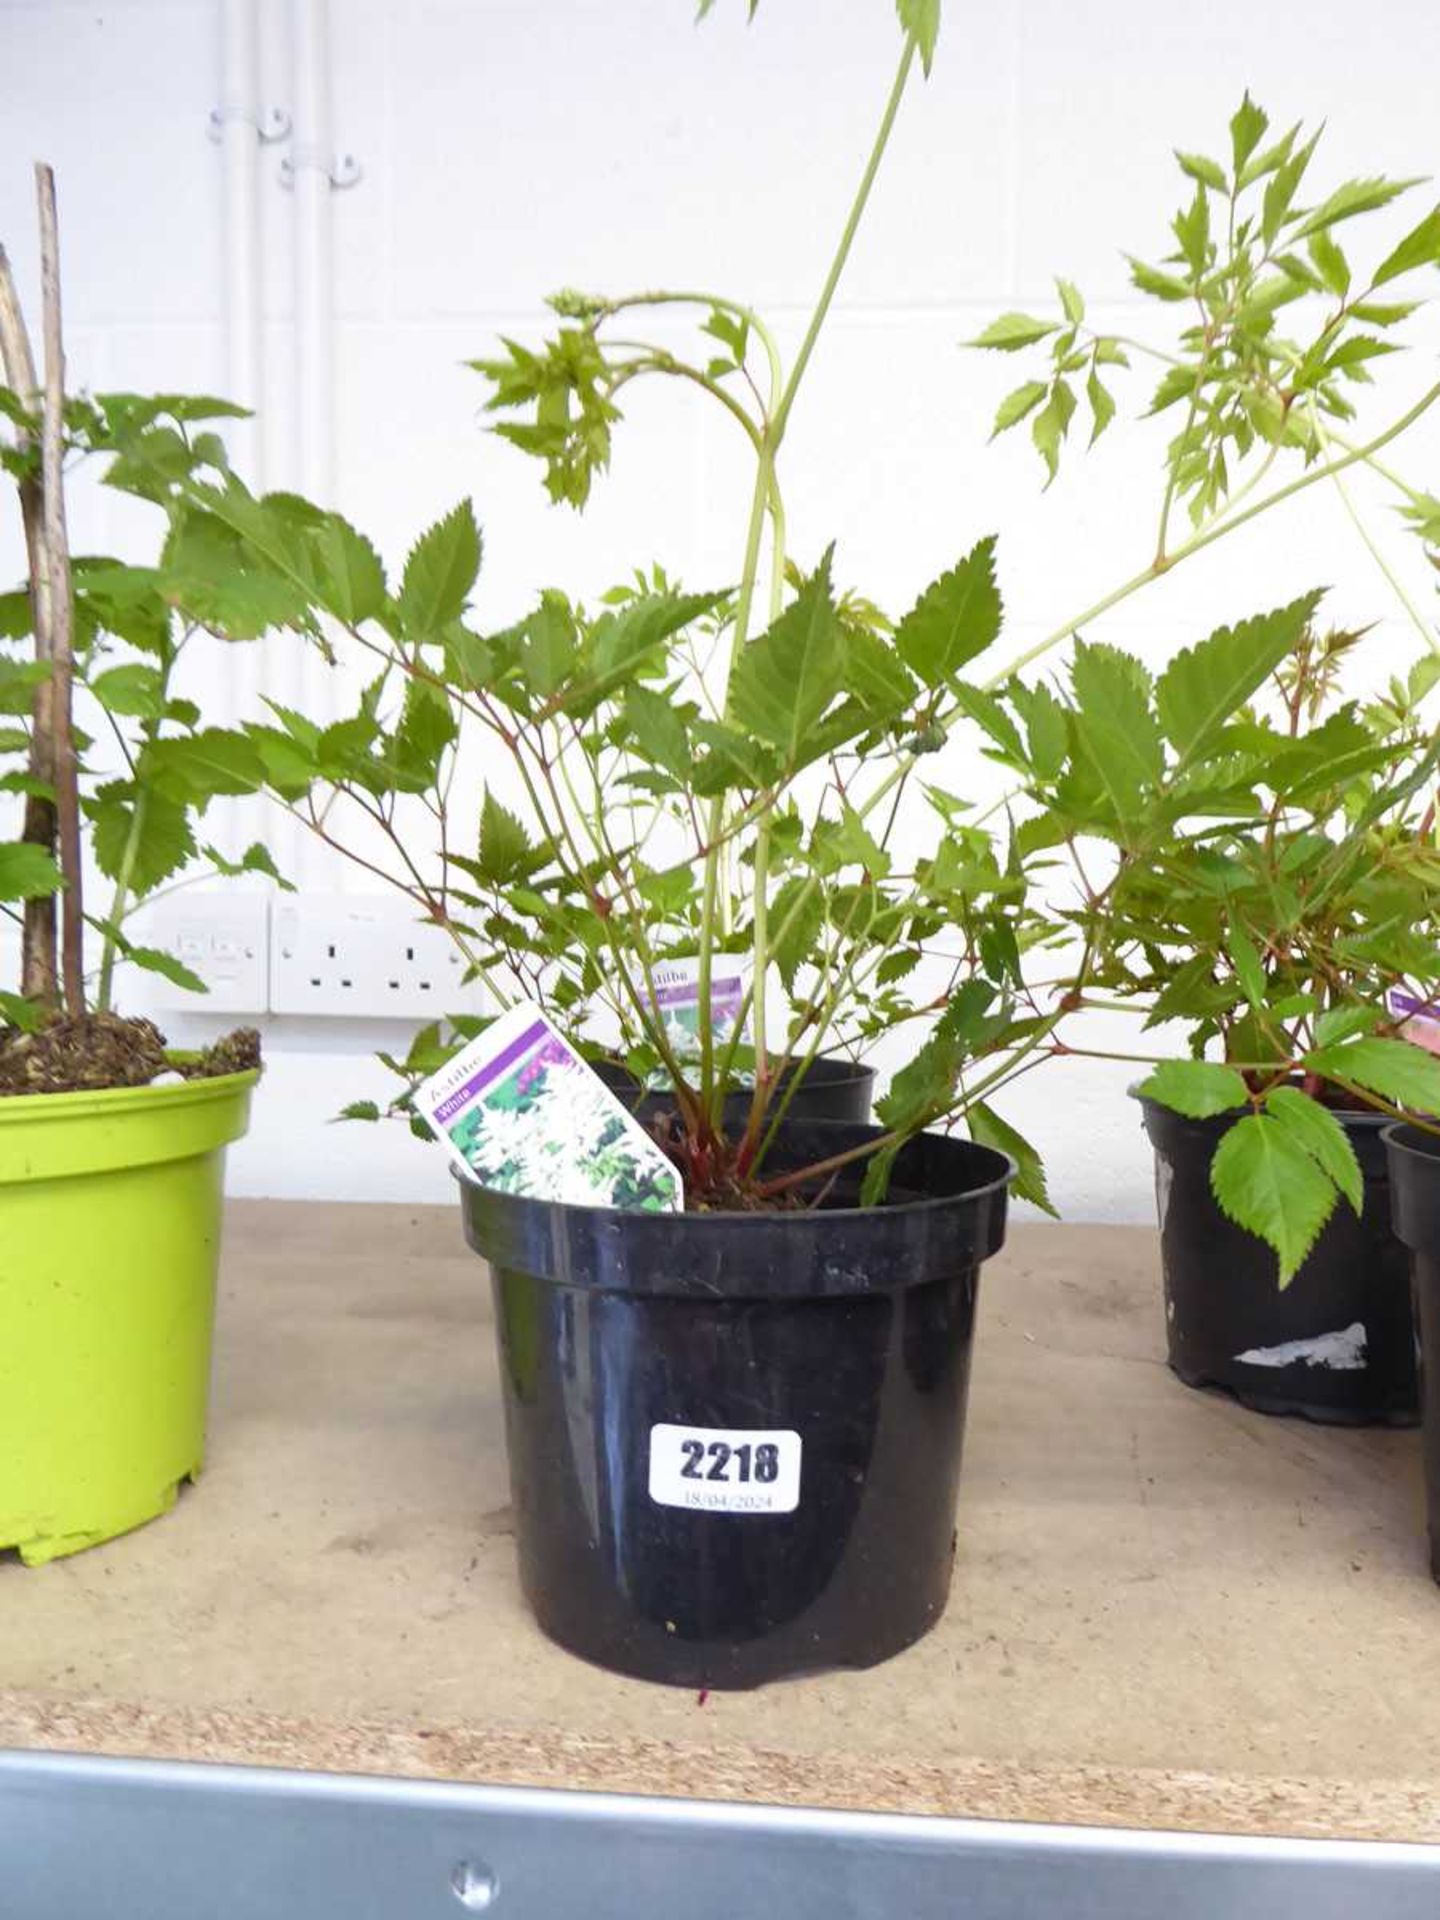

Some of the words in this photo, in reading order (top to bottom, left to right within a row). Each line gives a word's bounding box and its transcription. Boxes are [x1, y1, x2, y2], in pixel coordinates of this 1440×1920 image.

[437, 1088, 472, 1115] White
[680, 1440, 779, 1483] 2218
[684, 1490, 773, 1508] 18/04/2024
